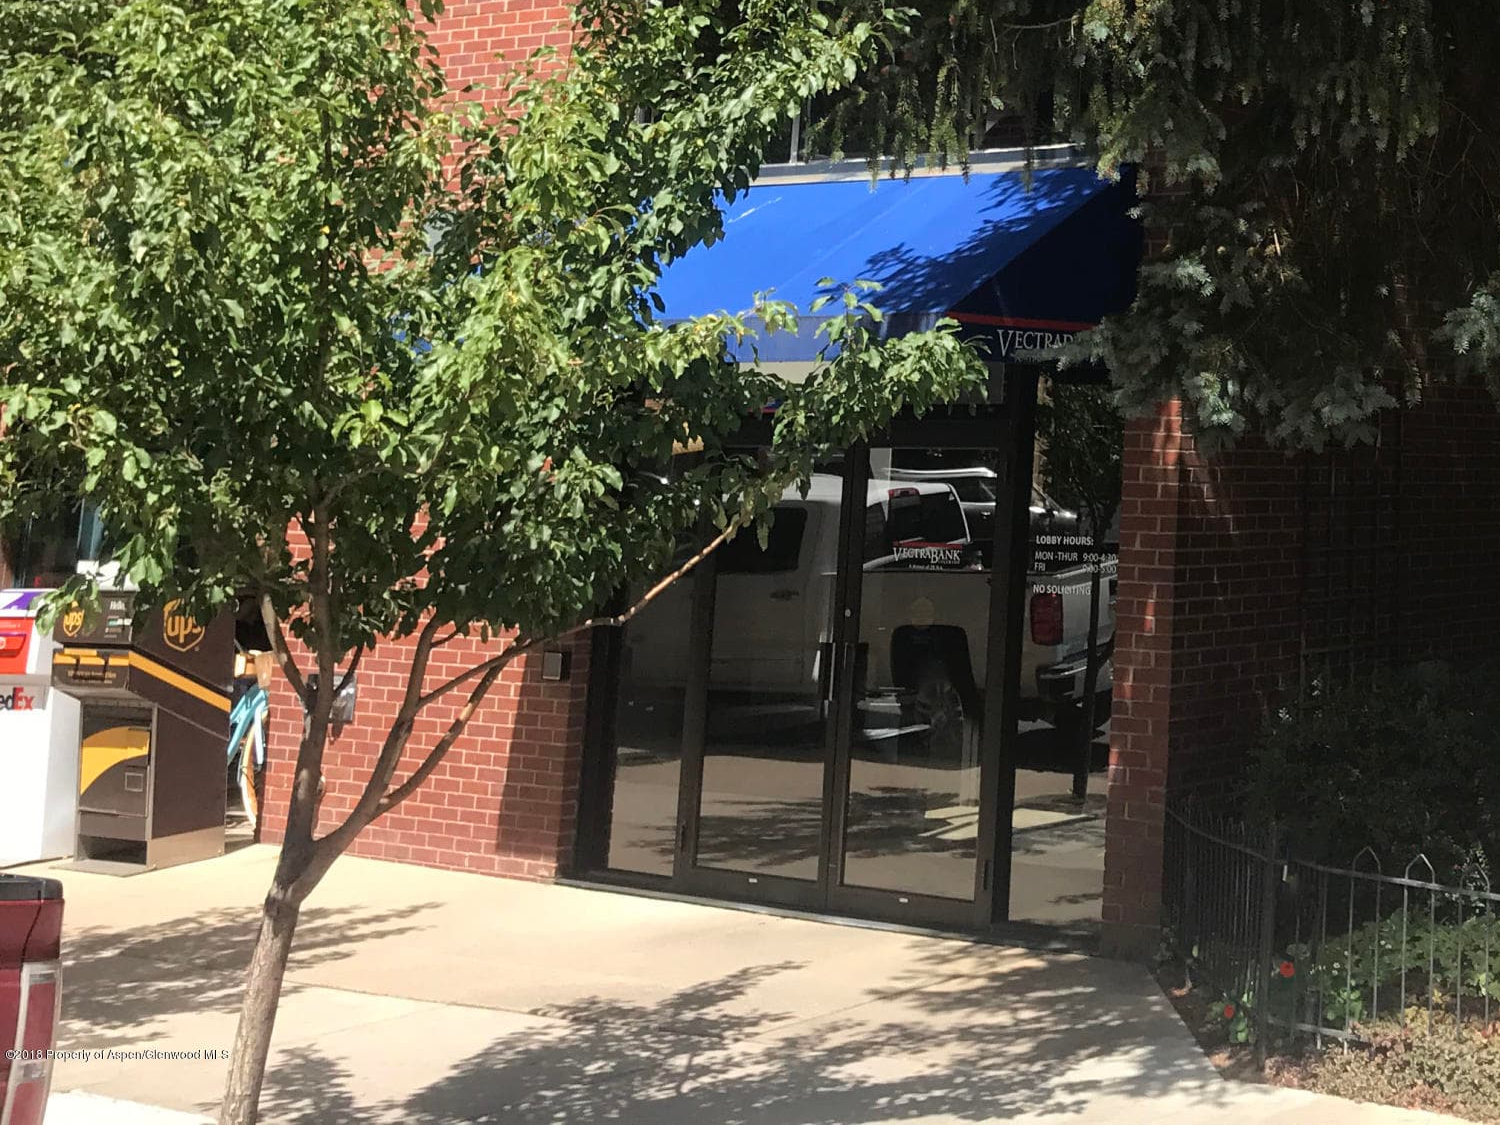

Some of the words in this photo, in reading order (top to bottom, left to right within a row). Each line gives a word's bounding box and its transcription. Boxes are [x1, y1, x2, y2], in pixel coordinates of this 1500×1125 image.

[1036, 535, 1061, 545] LOBBY
[1063, 536, 1094, 546] HOURS:
[1035, 551, 1053, 560] MON
[1033, 584, 1045, 593] NO
[0, 687, 33, 711] edEx
